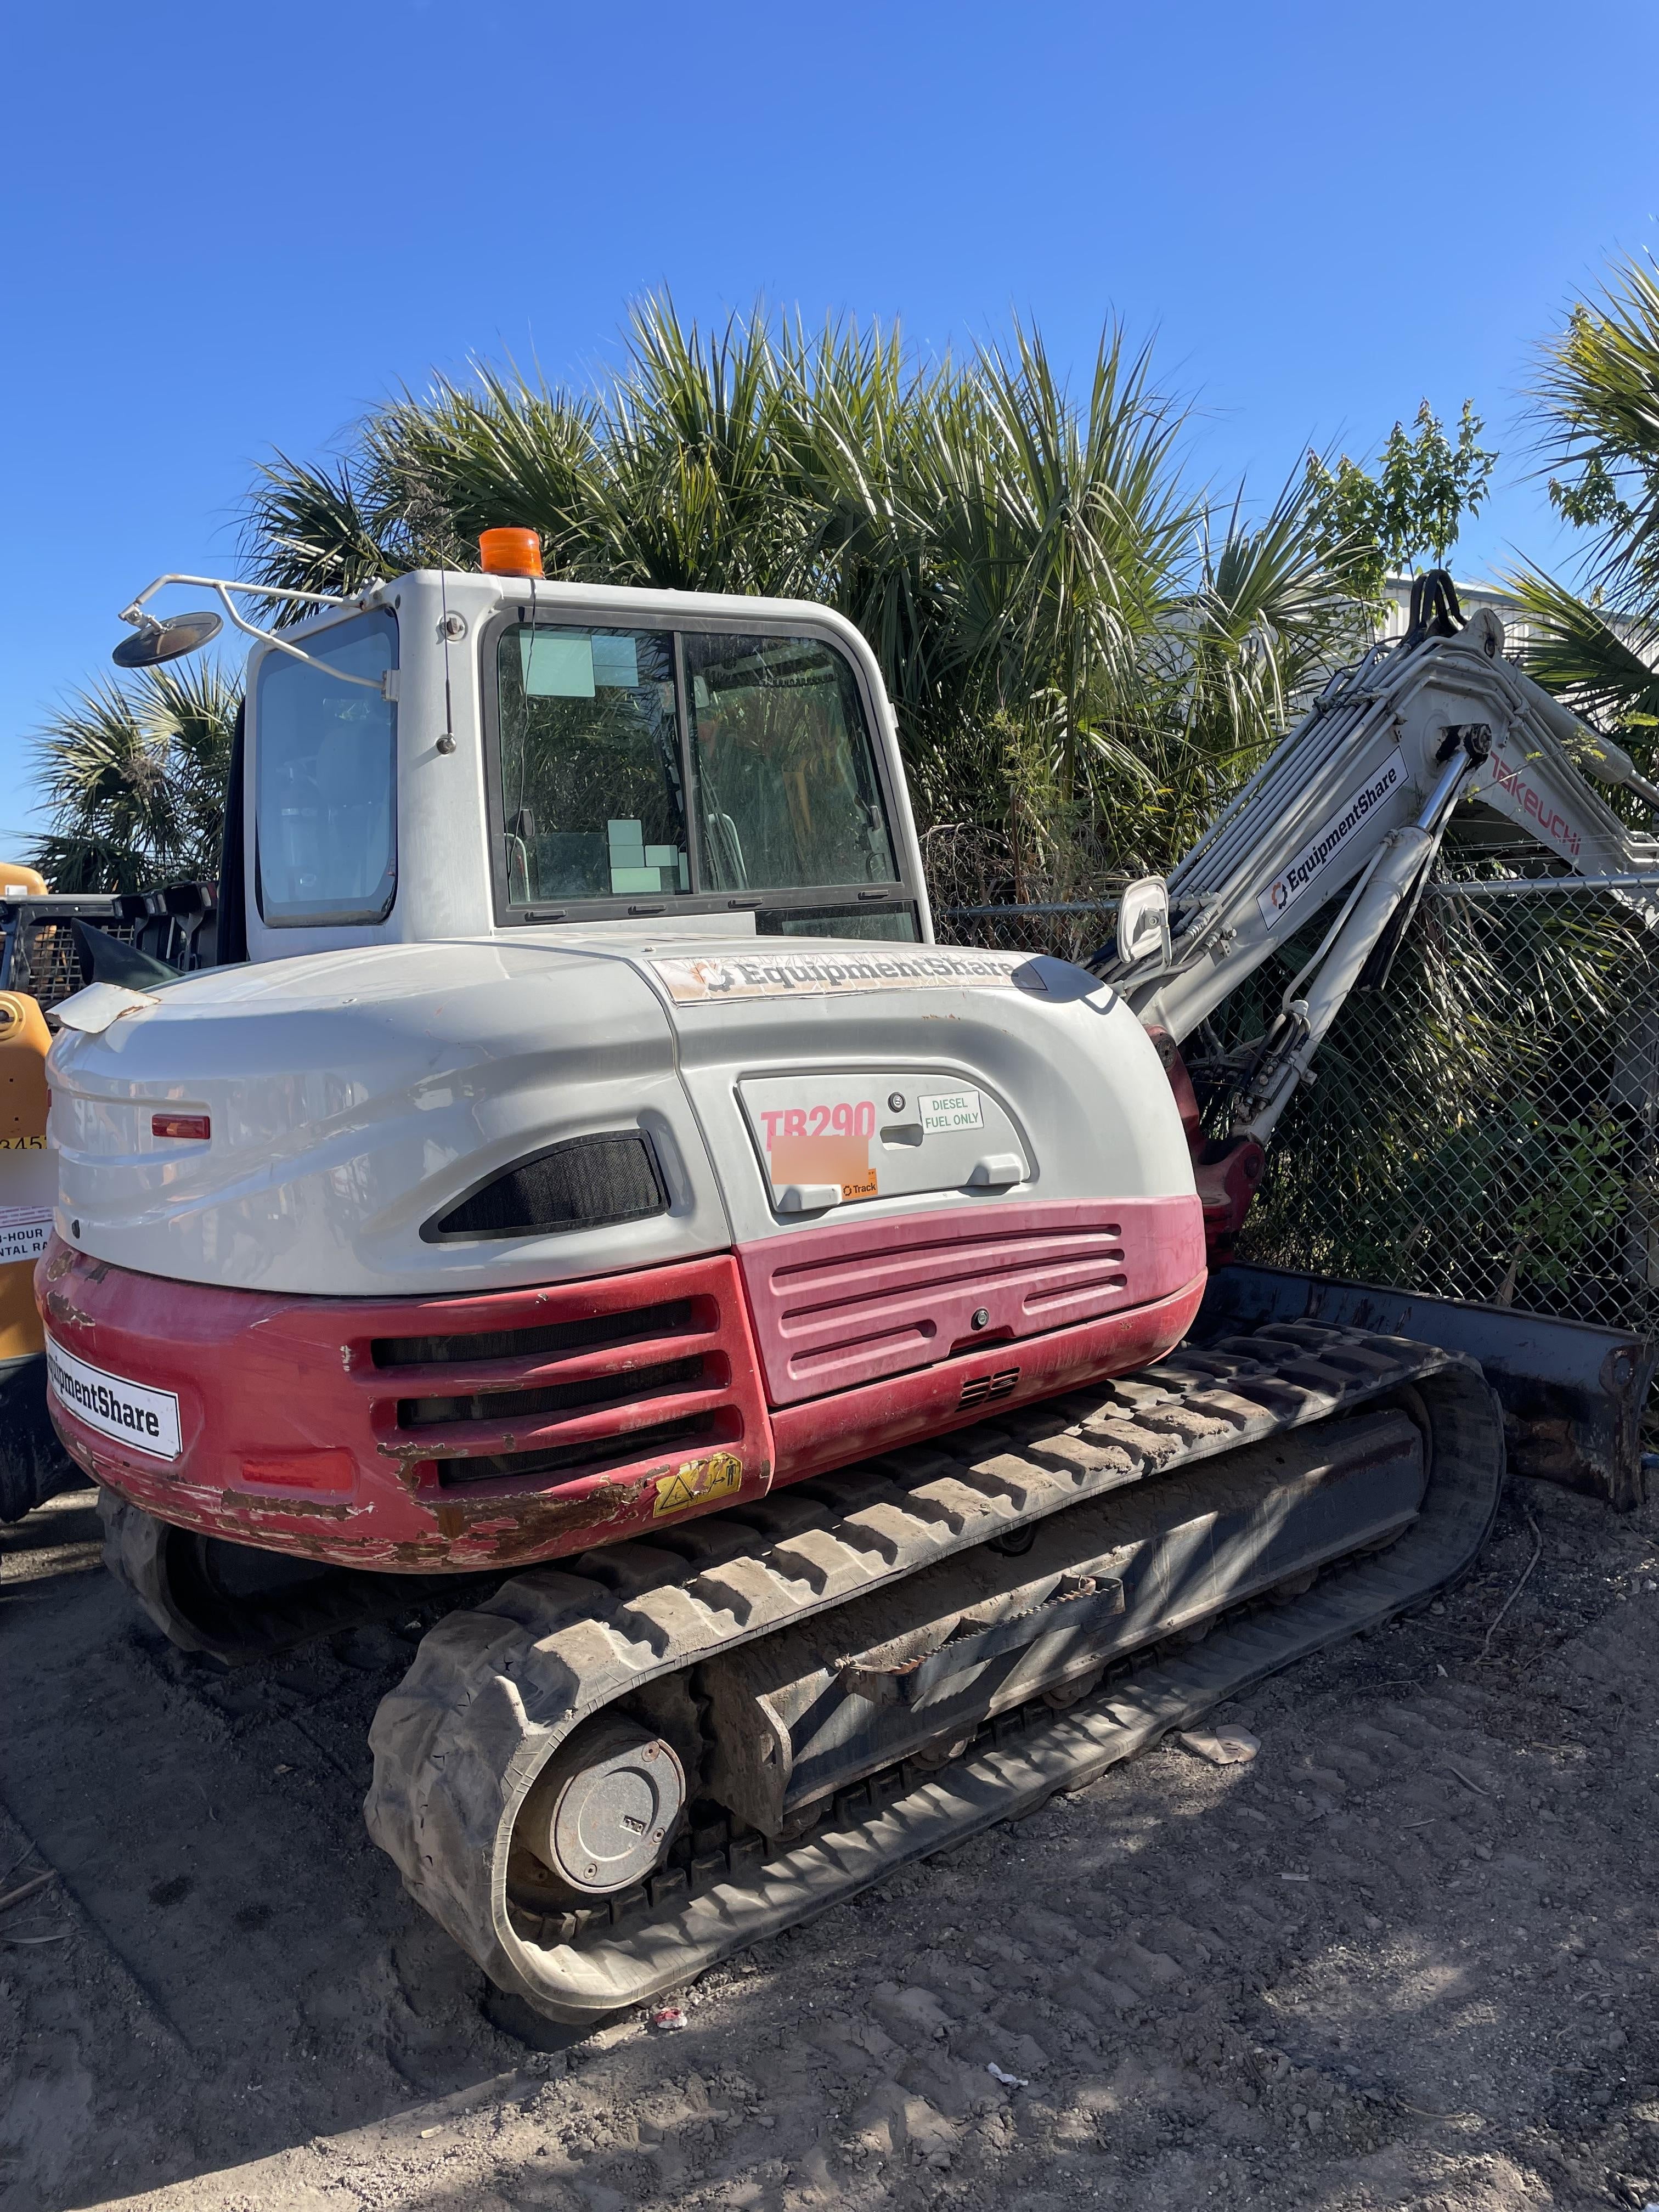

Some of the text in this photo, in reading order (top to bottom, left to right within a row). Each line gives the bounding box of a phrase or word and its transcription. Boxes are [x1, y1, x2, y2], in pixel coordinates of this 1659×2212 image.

[1286, 768, 1397, 892] EquipmentShare
[733, 956, 1019, 988] EquipmentShare
[932, 1097, 968, 1110] DIESEL
[925, 1112, 979, 1128] FUEL ONLY
[853, 1182, 876, 1193] Track
[0, 1228, 43, 1243] -HOUR
[48, 1353, 160, 1437] quipmentShare
